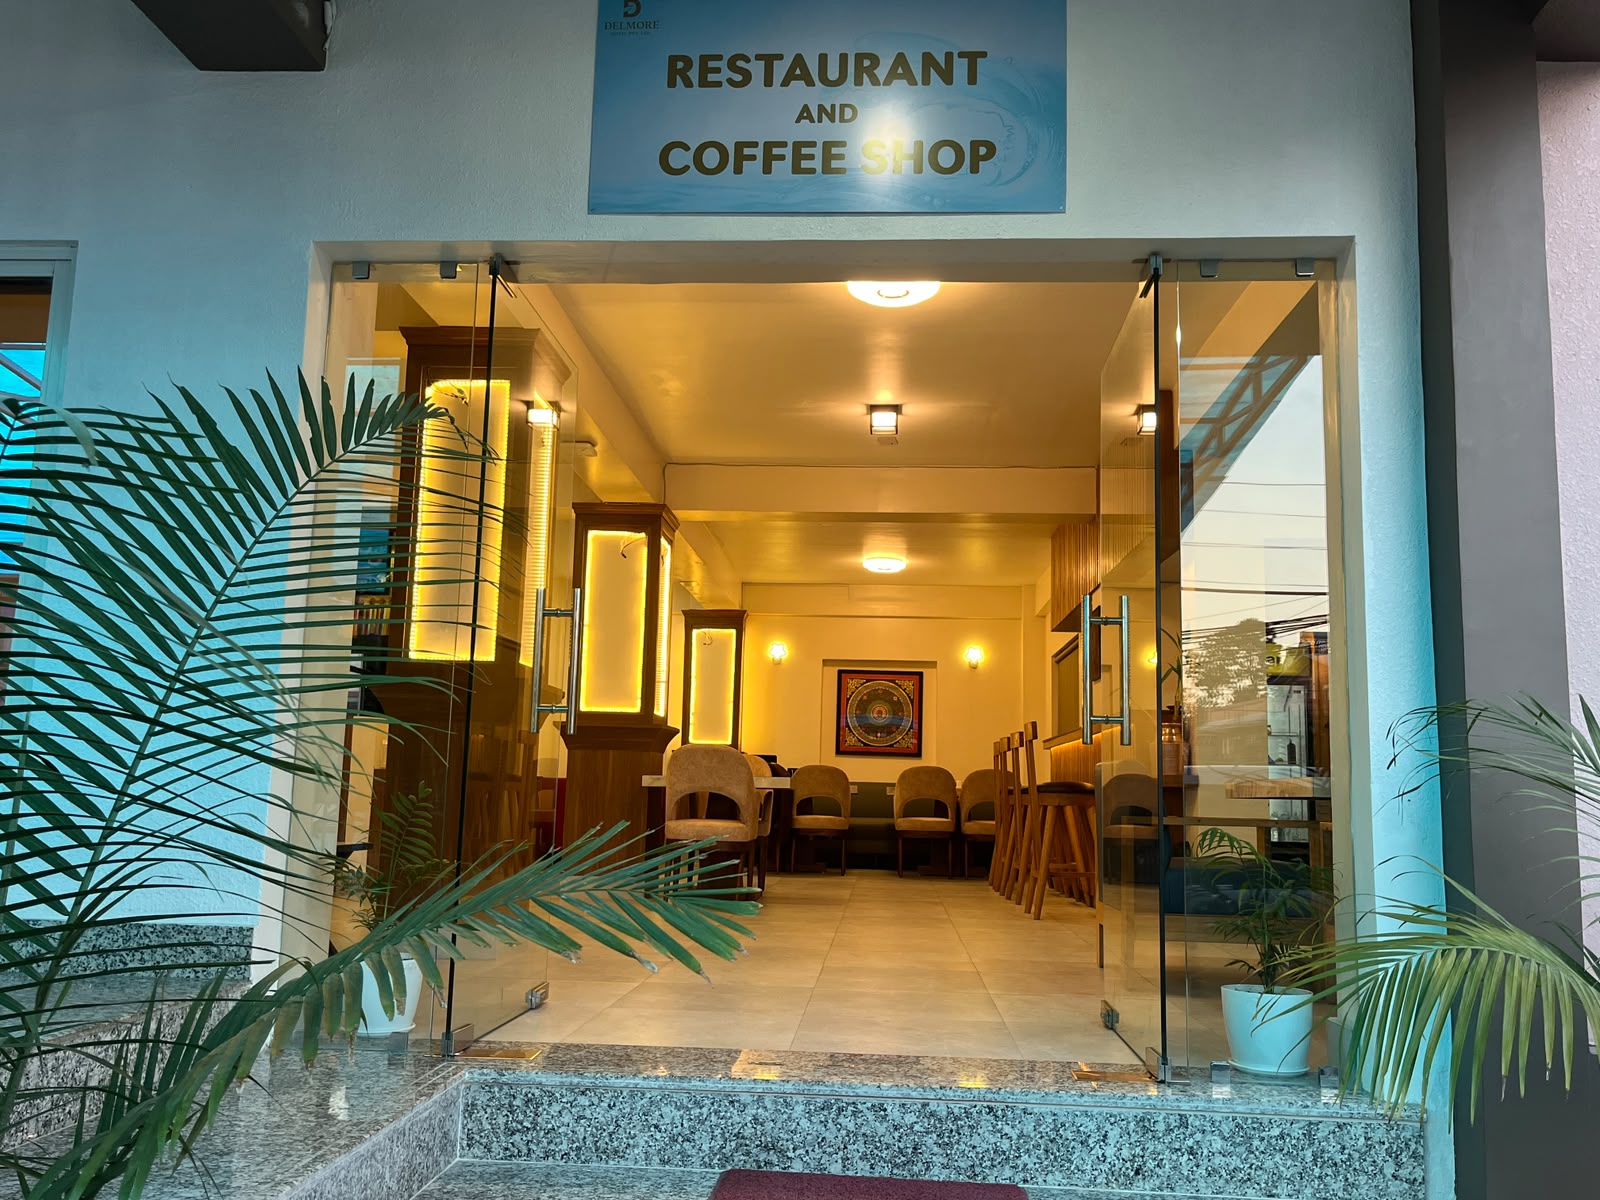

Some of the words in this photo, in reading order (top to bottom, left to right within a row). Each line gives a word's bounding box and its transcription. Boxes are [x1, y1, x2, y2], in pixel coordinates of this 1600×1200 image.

[604, 20, 659, 30] DELMORE
[666, 51, 988, 88] RESTAURANT
[795, 103, 858, 124] AND
[658, 140, 848, 175] COFFEE
[860, 139, 997, 175] SHOP
